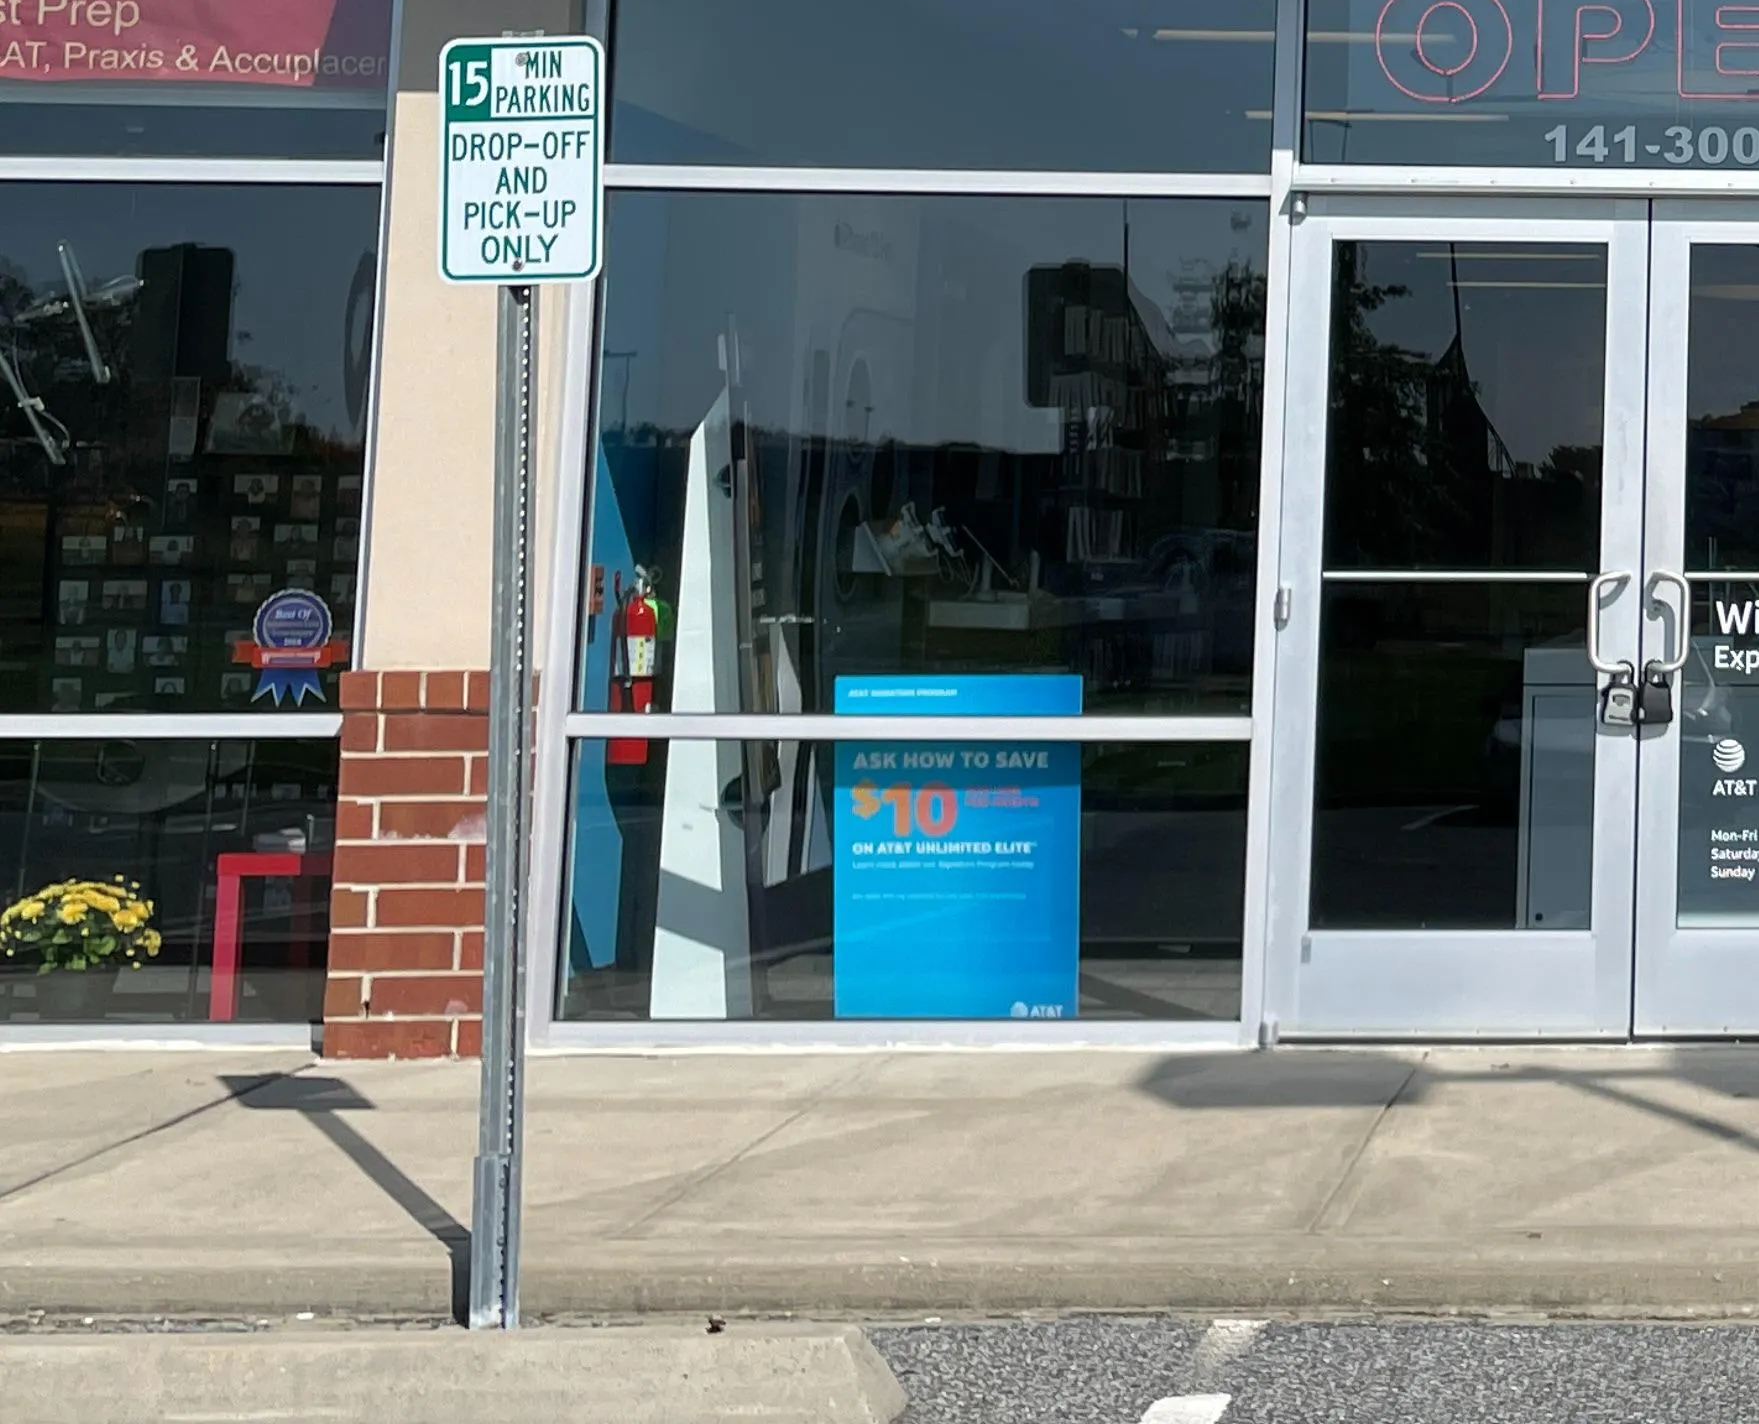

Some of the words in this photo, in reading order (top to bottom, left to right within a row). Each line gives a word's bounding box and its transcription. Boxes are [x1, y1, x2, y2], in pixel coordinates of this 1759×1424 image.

[64, 41, 164, 70] Praxis
[175, 45, 199, 72] &
[208, 46, 386, 81] Accuplacer
[524, 50, 564, 80] MIN
[448, 60, 490, 107] 15
[495, 83, 591, 114] PARKING
[451, 129, 591, 162] DROP-OFF
[494, 166, 549, 196] AND
[463, 199, 577, 231] PICK-UP
[480, 233, 560, 265] ONLY
[853, 751, 897, 770] ASK
[903, 751, 956, 769] HOW
[960, 751, 989, 769] TO
[995, 751, 1049, 769] SAVE
[1712, 779, 1758, 796] AT&T
[850, 779, 958, 839] $10
[852, 842, 874, 856] ON
[876, 842, 912, 855] AT&T
[916, 841, 992, 855] UNLIMITED
[1710, 829, 1759, 843] Mon-Fri
[1710, 865, 1757, 881] Sunday
[1029, 1004, 1064, 1019] AT&T
